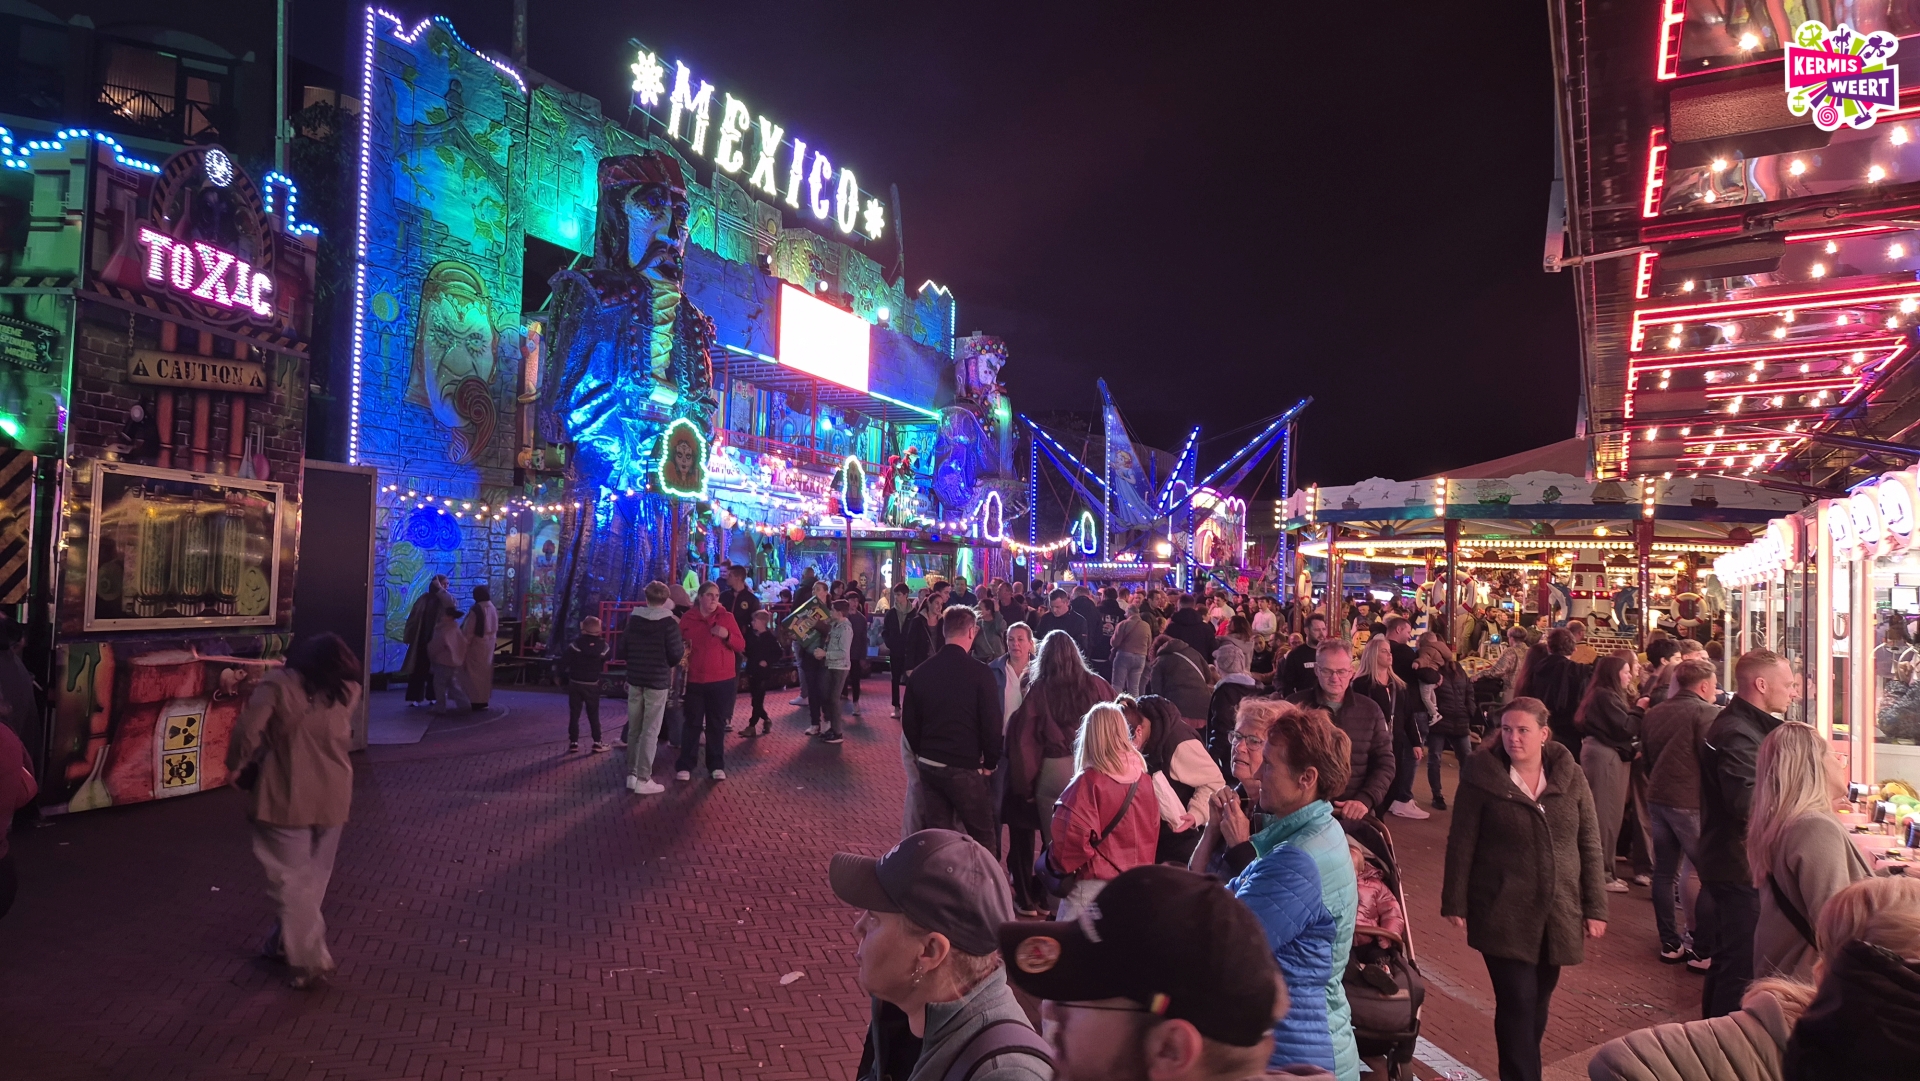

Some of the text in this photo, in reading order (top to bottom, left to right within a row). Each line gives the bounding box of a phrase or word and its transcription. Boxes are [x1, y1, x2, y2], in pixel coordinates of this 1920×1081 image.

[667, 59, 859, 234] MEXICO
[139, 227, 273, 315] TOXIC
[156, 358, 244, 385] CAUTION
